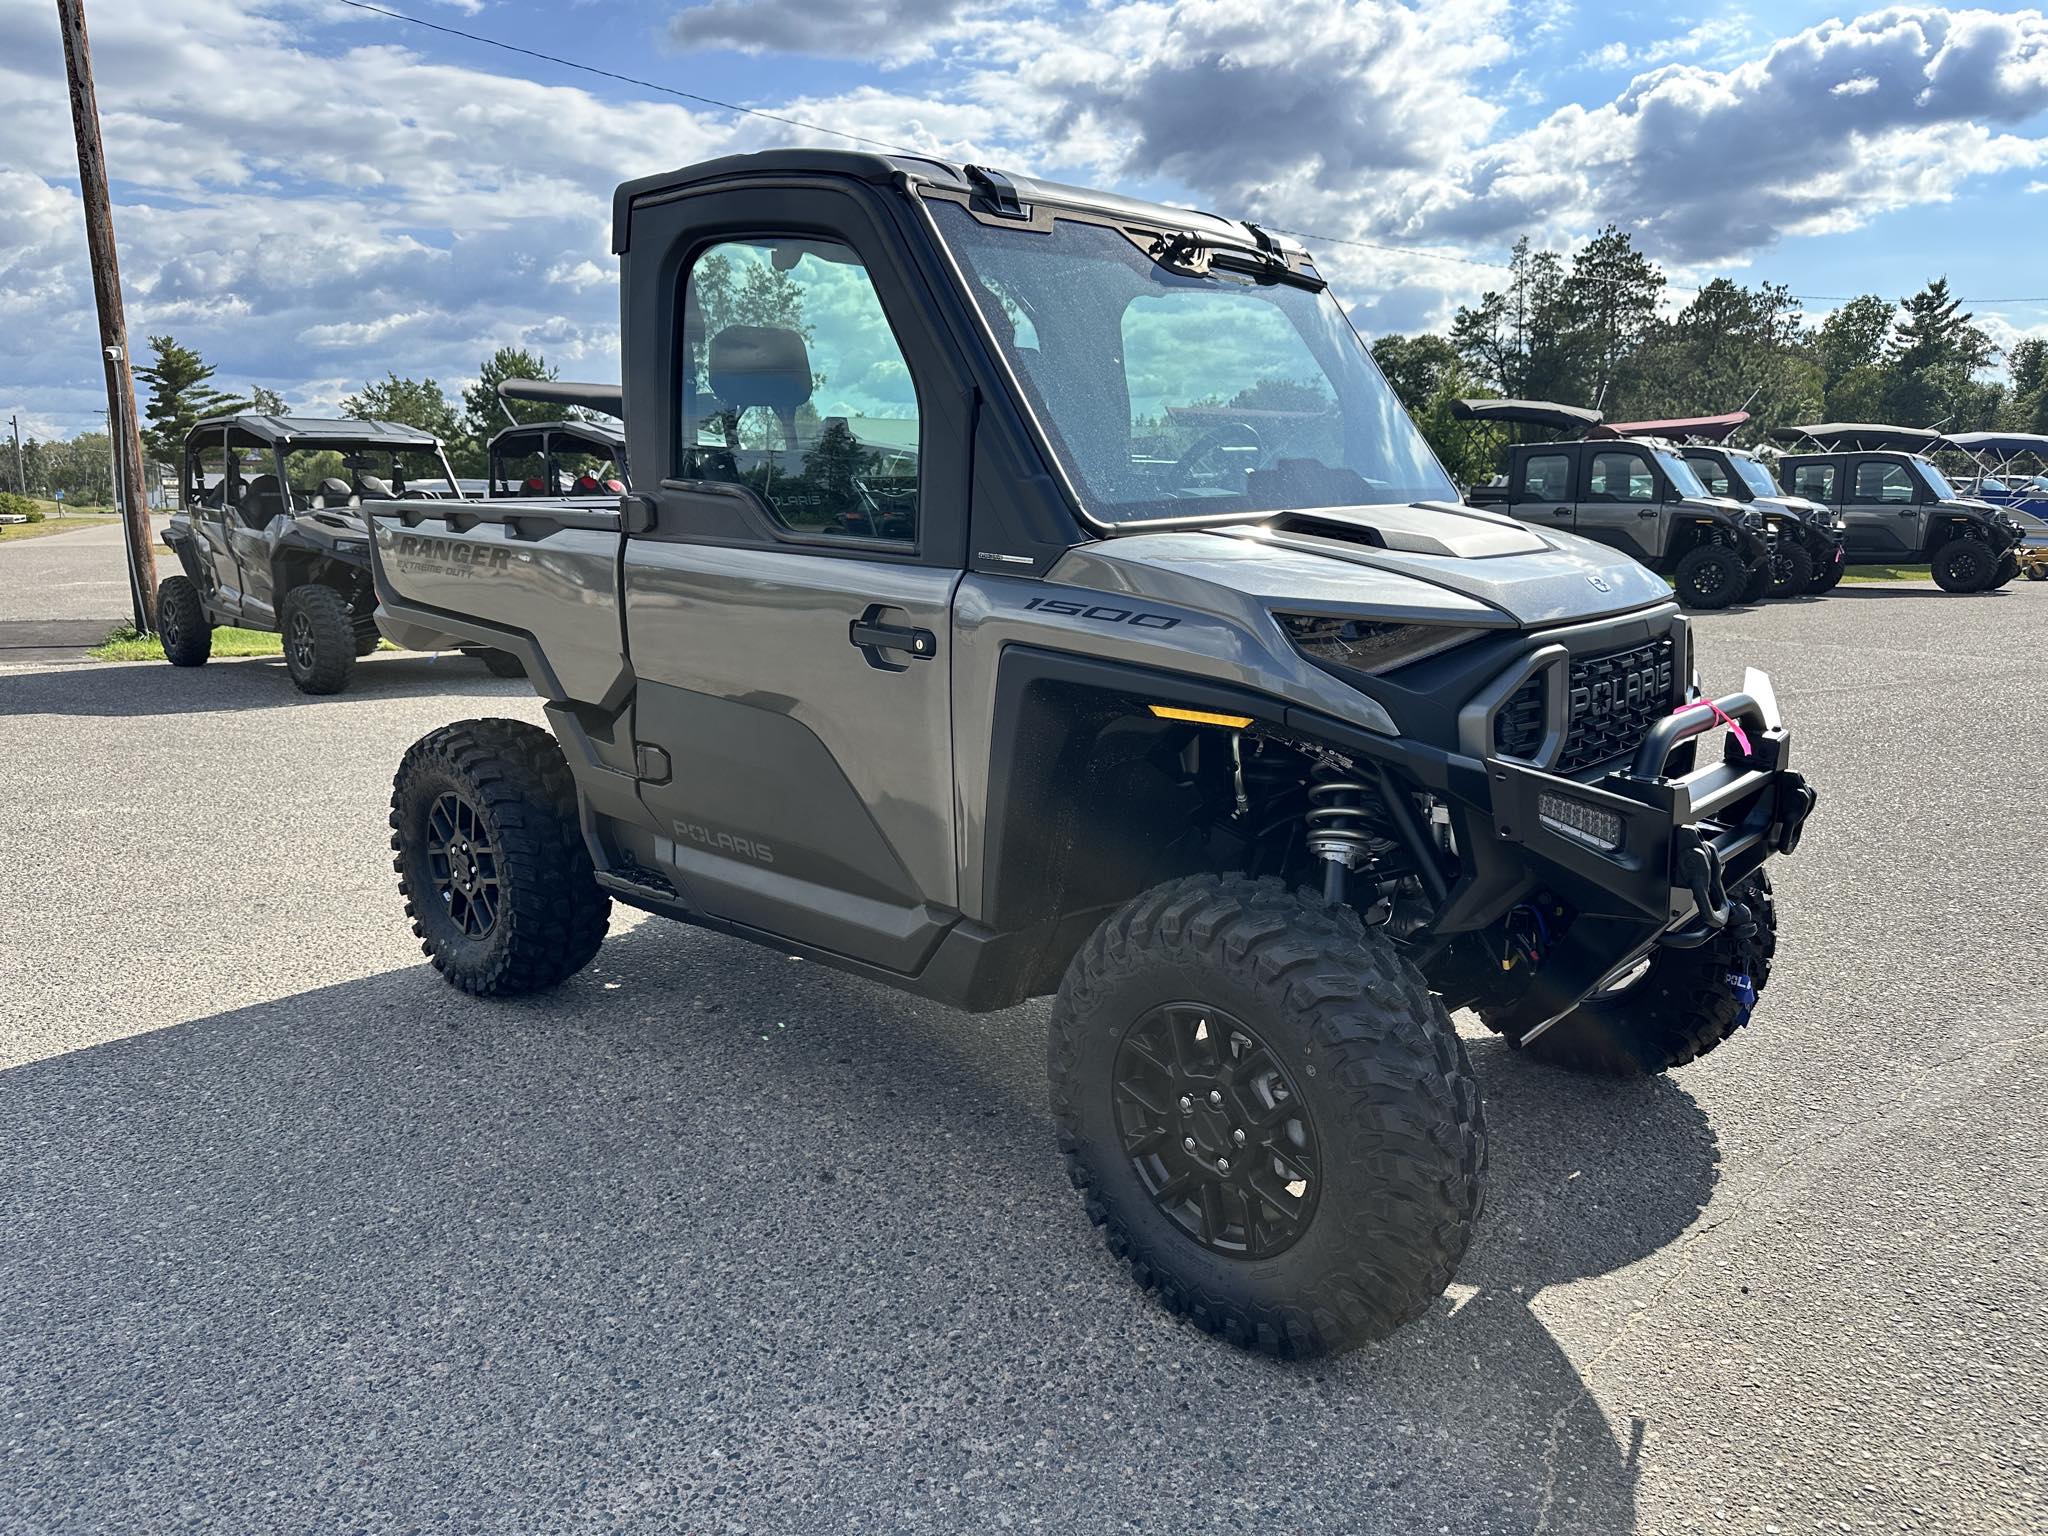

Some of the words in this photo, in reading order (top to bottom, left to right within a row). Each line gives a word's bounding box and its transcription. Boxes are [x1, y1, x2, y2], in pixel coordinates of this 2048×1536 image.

[769, 495, 822, 507] OLARIS
[397, 560, 442, 574] EXTREME
[445, 567, 474, 579] DUTY
[400, 536, 511, 570] RANGER
[1023, 597, 1182, 630] 1500
[1570, 661, 1672, 722] POLARIS
[673, 820, 774, 863] POLARIS
